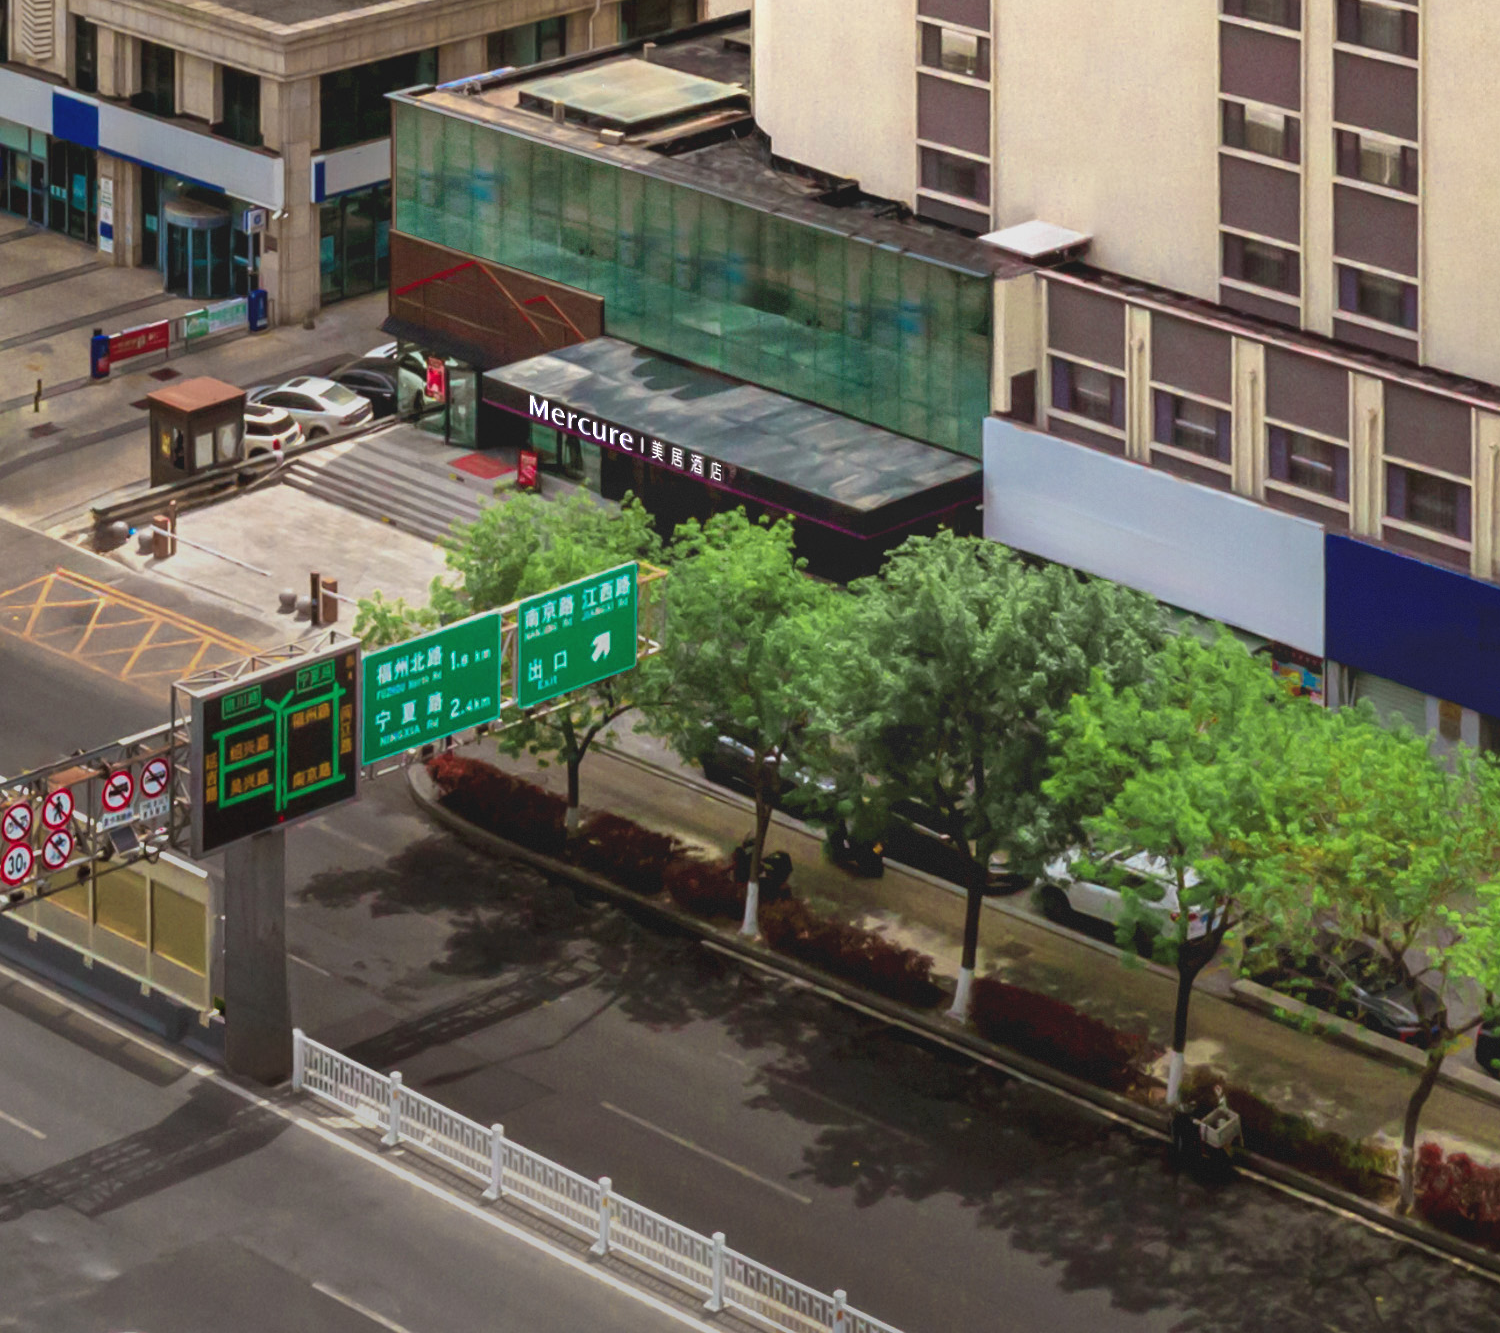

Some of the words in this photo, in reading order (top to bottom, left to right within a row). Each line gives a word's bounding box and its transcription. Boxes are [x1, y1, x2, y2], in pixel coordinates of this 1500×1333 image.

[529, 395, 634, 451] Mercure
[651, 440, 722, 482] 美居酒店
[524, 593, 574, 629] 南京路
[582, 574, 631, 610] 江西路
[377, 645, 442, 686] 福州北路
[528, 650, 567, 682] 出口
[375, 691, 442, 732] 宁夏路
